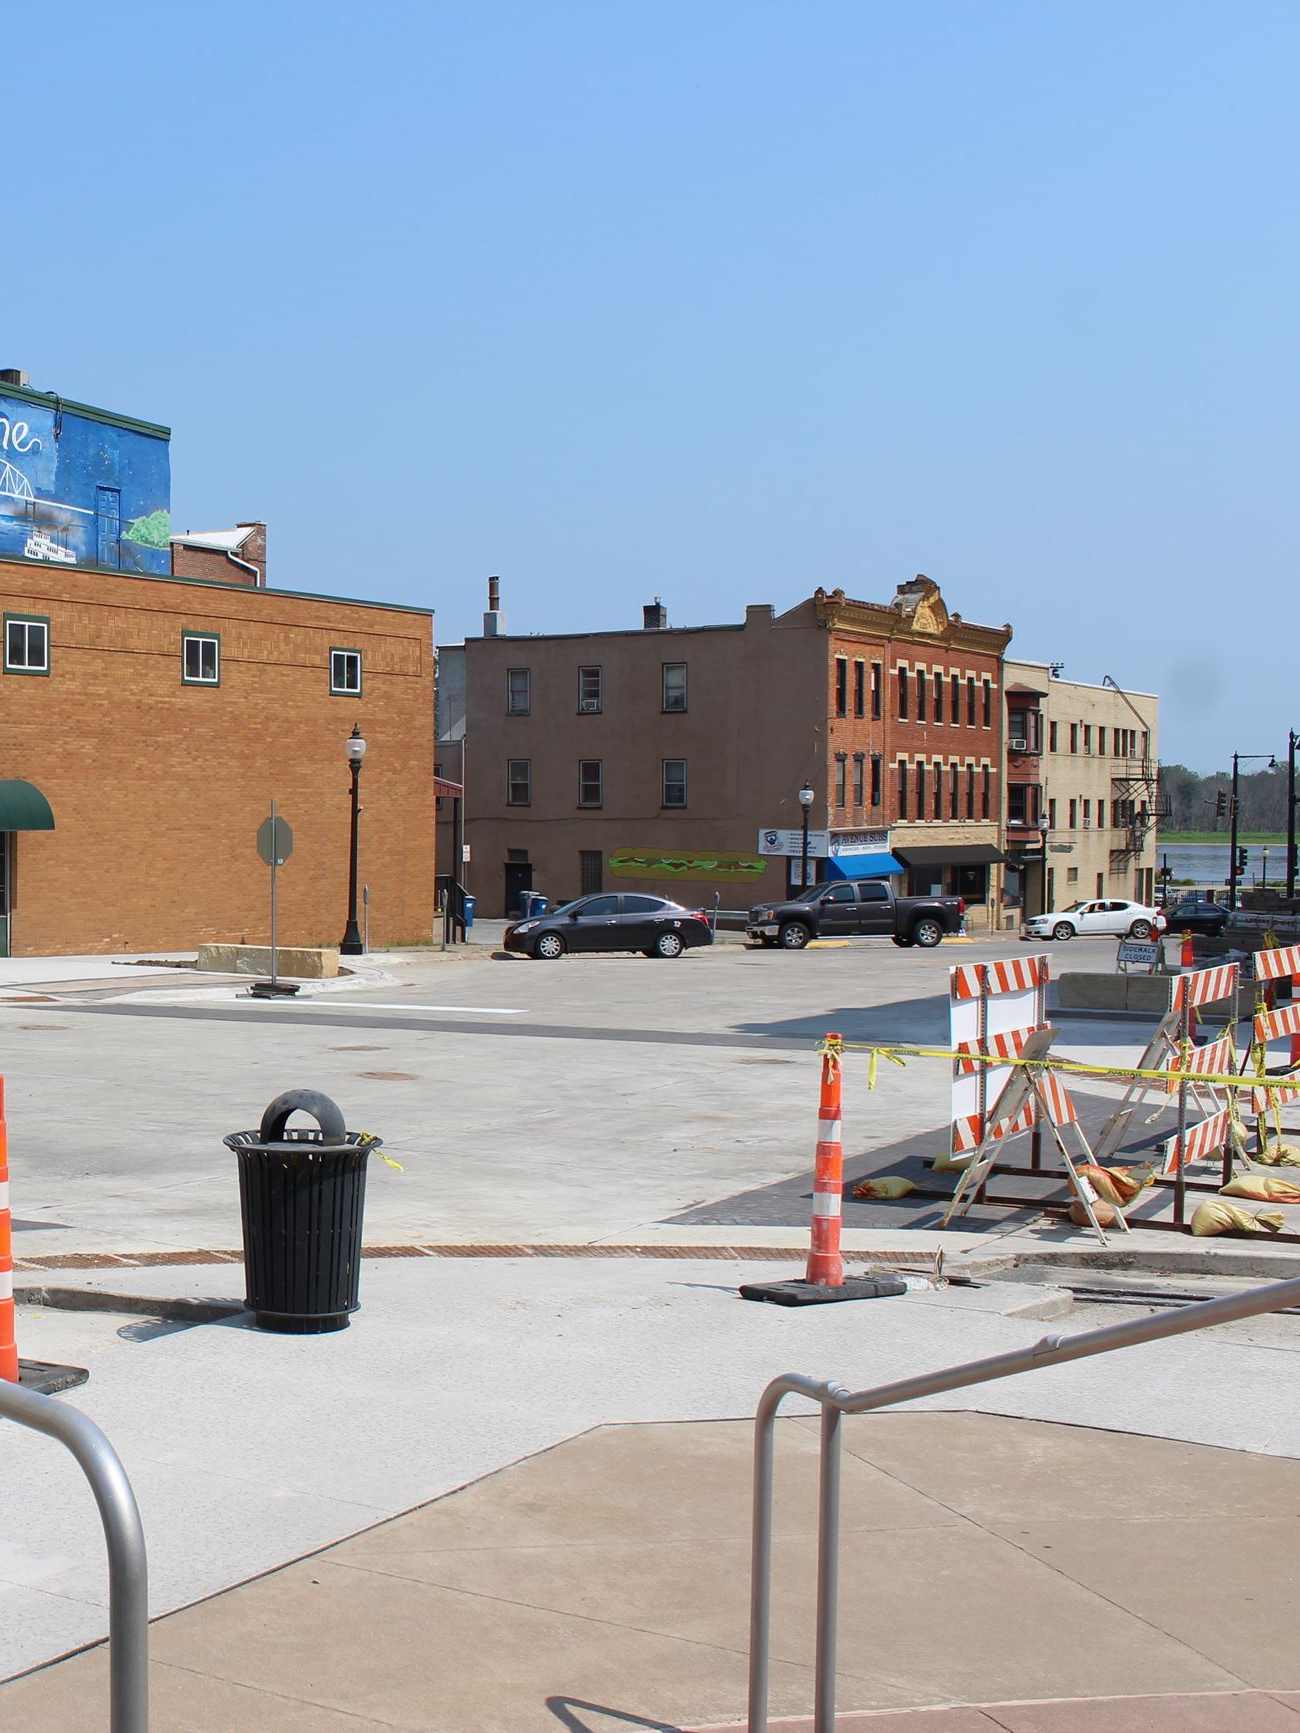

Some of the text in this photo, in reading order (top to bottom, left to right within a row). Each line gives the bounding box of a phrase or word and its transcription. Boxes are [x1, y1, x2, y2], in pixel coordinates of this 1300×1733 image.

[841, 832, 868, 844] AVENUE
[1123, 945, 1156, 954] SIDEWALK
[1125, 953, 1152, 961] CLOSED
